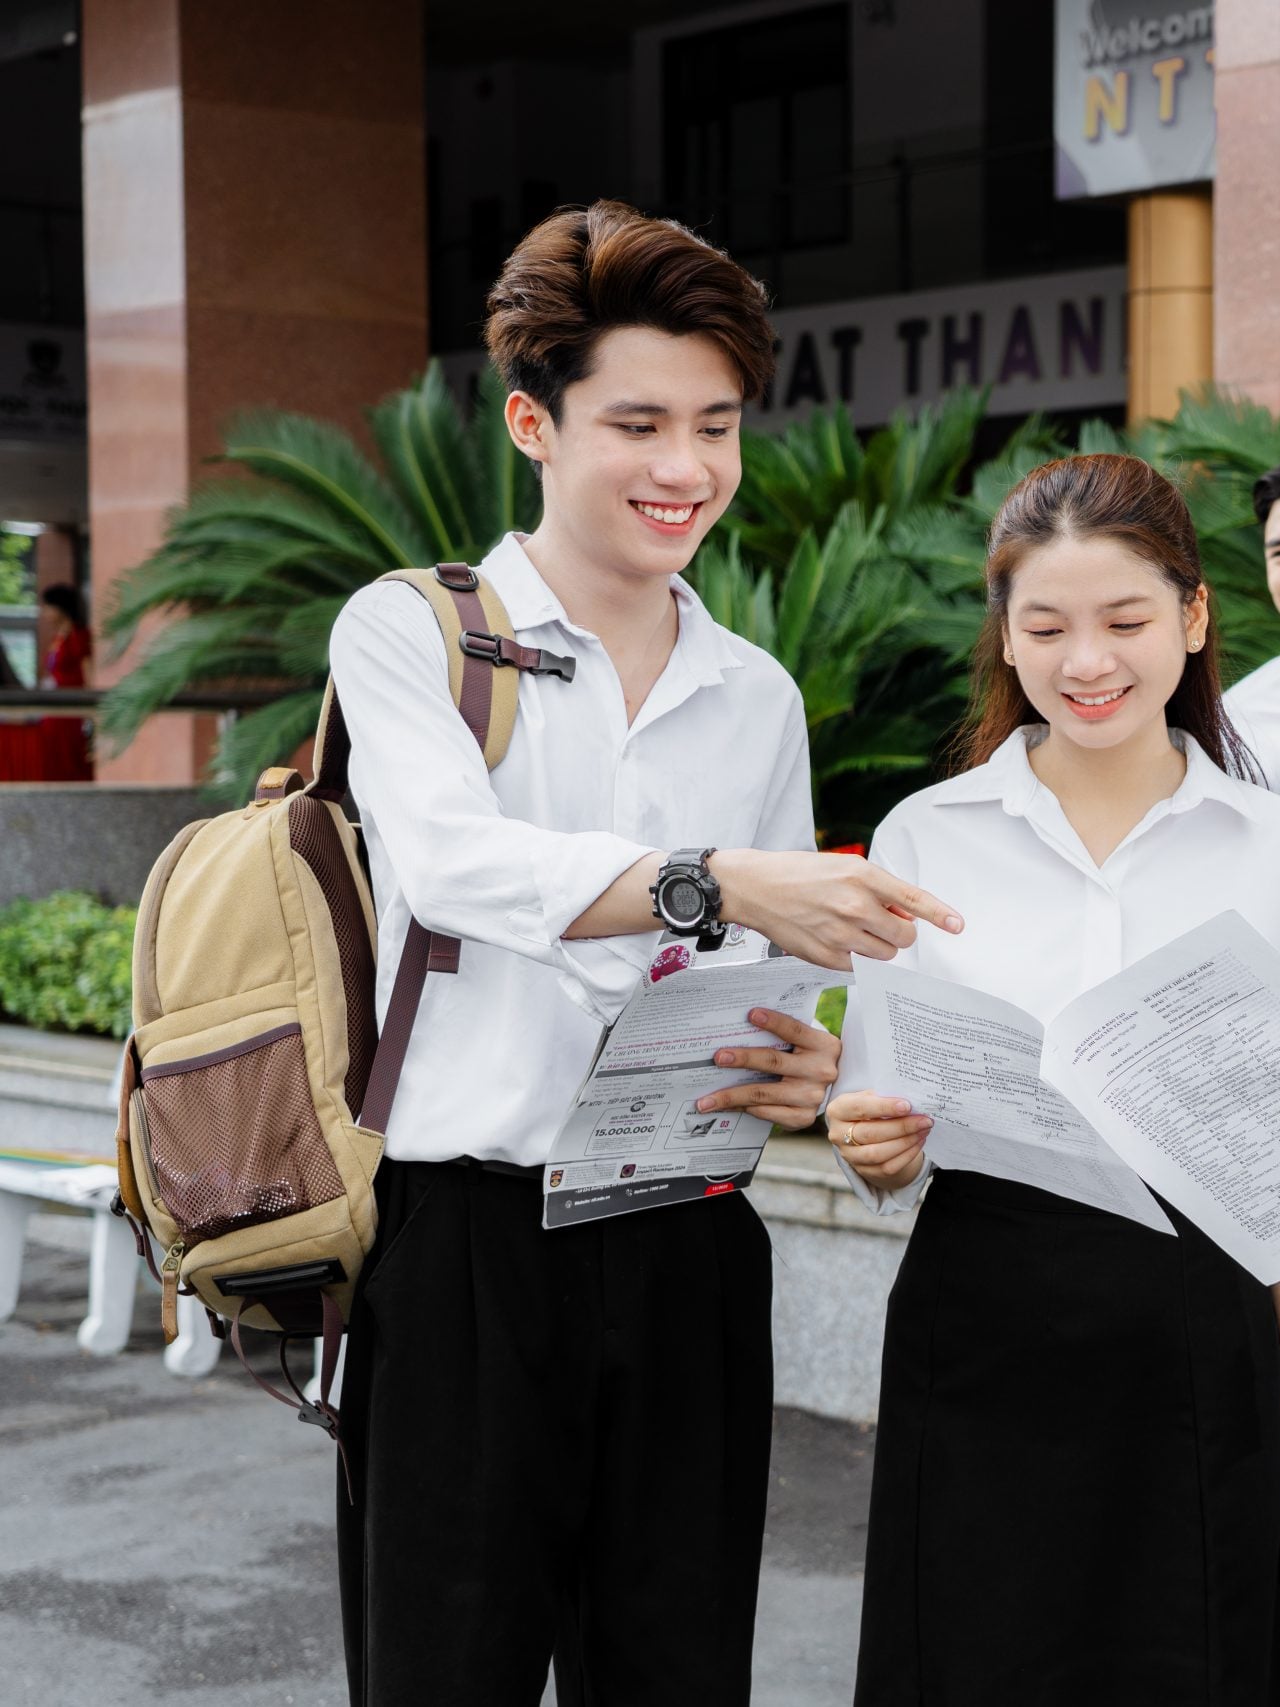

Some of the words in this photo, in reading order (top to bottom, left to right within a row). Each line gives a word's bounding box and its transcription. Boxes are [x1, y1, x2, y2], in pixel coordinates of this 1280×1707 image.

[1083, 49, 1214, 141] NT
[762, 324, 862, 412] AT
[896, 296, 1128, 398] THAN
